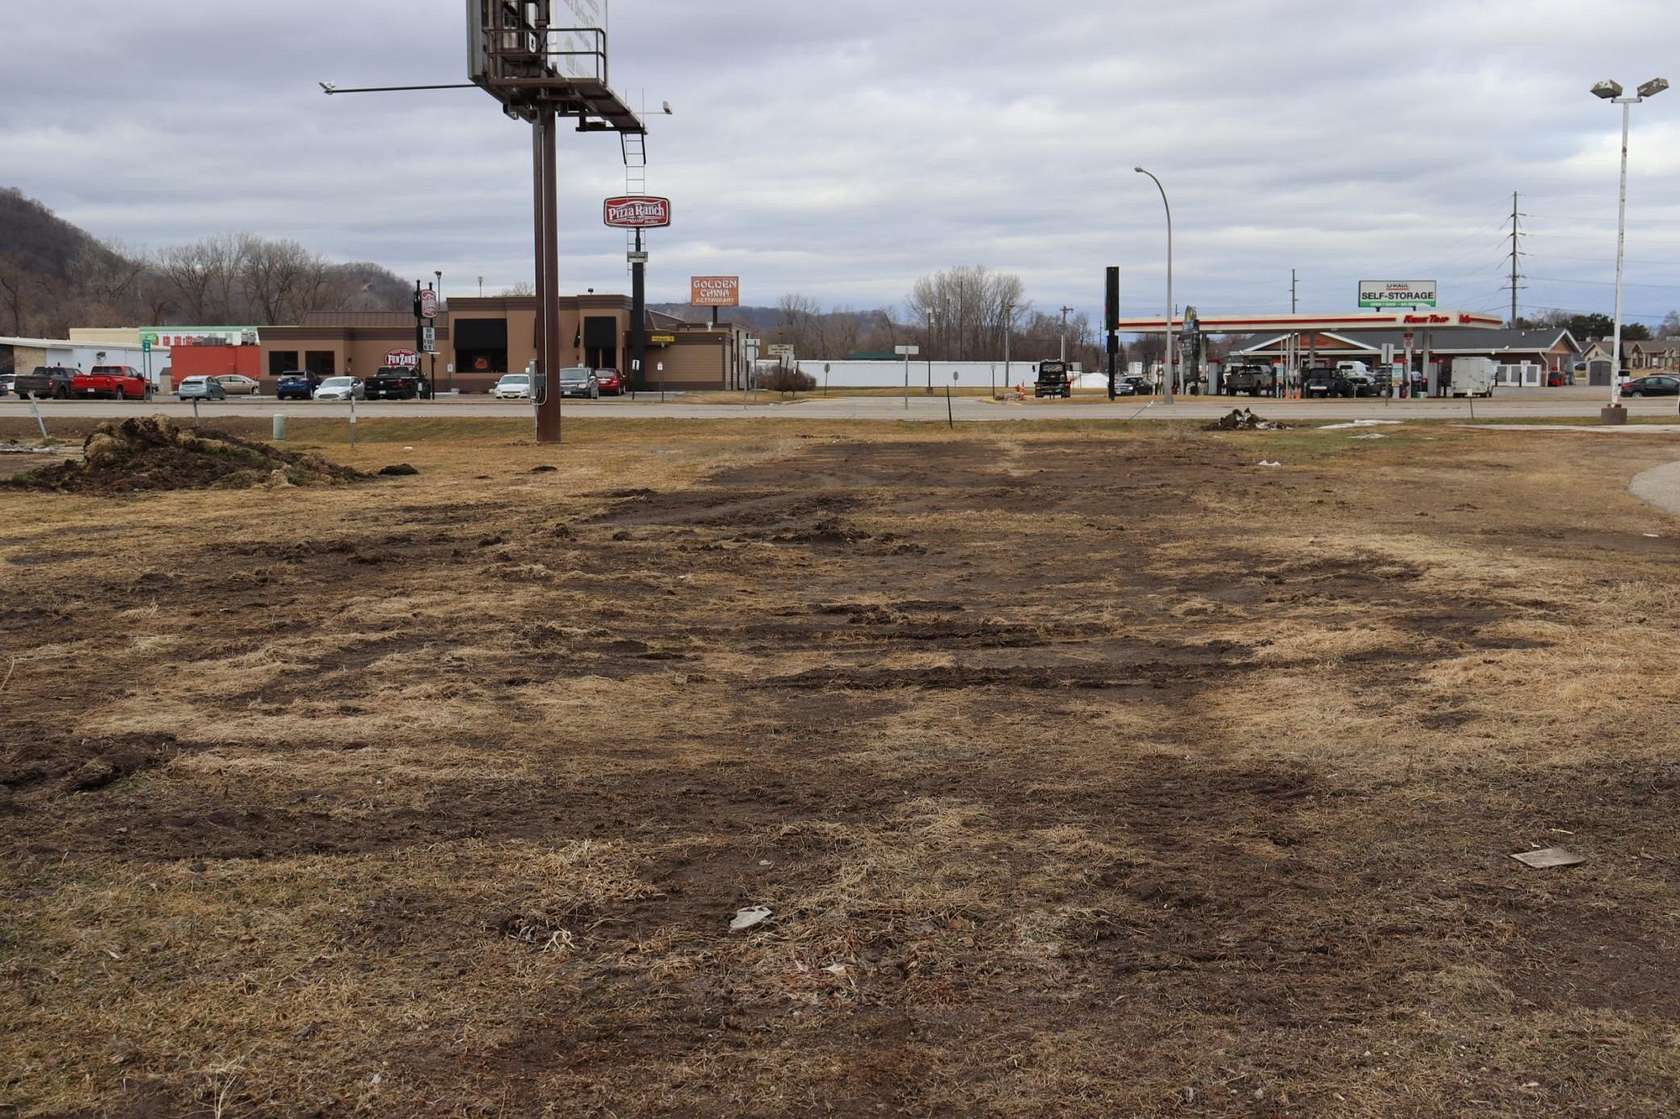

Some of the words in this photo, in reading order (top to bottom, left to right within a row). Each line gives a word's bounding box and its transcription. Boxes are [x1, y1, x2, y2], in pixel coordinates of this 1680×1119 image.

[608, 206, 634, 220] Pizza
[635, 203, 665, 217] Ranch
[693, 280, 737, 289] GOLDEN
[700, 289, 730, 298] CHINA
[1361, 291, 1434, 300] SELF-STORAGE
